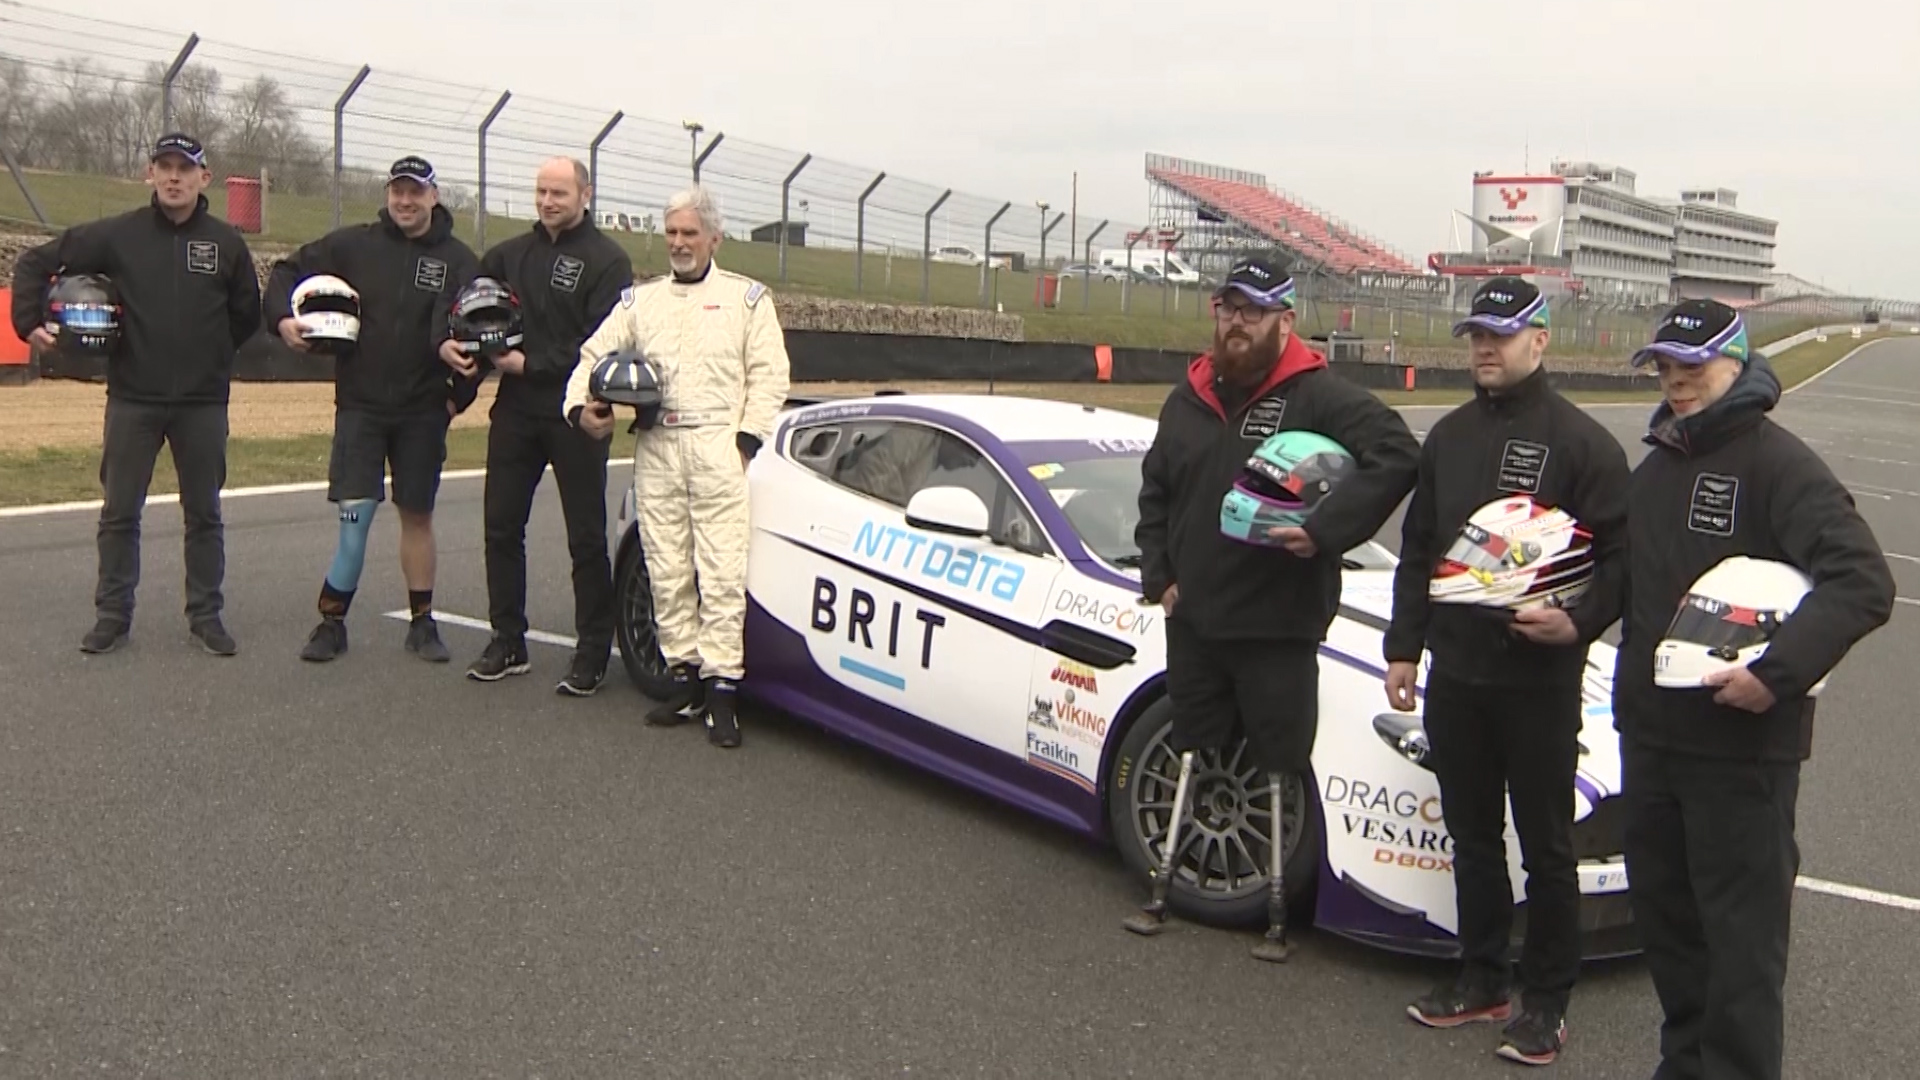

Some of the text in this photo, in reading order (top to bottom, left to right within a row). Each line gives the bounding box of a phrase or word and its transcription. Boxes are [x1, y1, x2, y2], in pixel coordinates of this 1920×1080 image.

[811, 575, 946, 669] BRIT
[1055, 589, 1153, 635] DRAGON
[1056, 700, 1106, 737] VIKING
[1027, 731, 1079, 768] Fraikin
[1325, 775, 1442, 824] DRAGO
